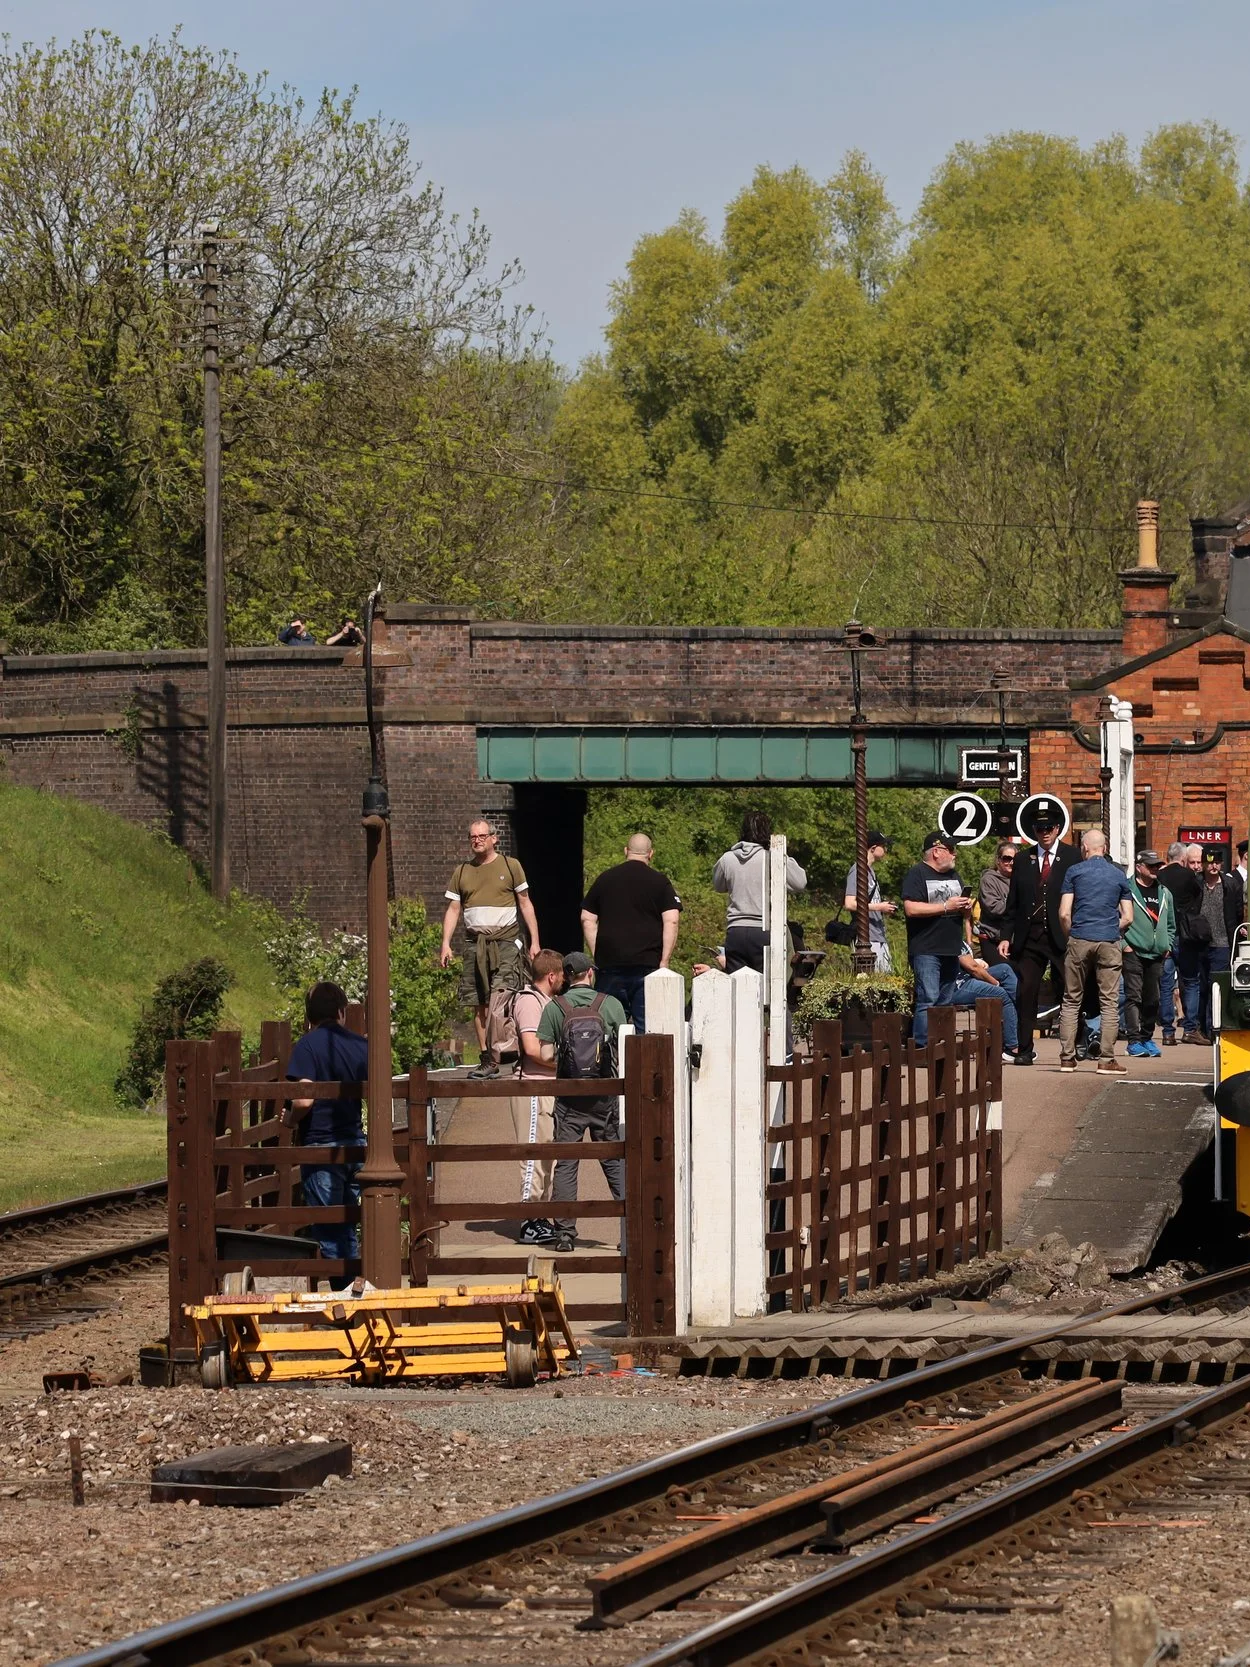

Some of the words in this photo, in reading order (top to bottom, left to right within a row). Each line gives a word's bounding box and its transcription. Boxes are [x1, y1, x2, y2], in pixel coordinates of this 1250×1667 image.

[969, 762, 1016, 770] GENTLEN
[953, 800, 977, 837] 2
[1189, 832, 1221, 840] LNER
